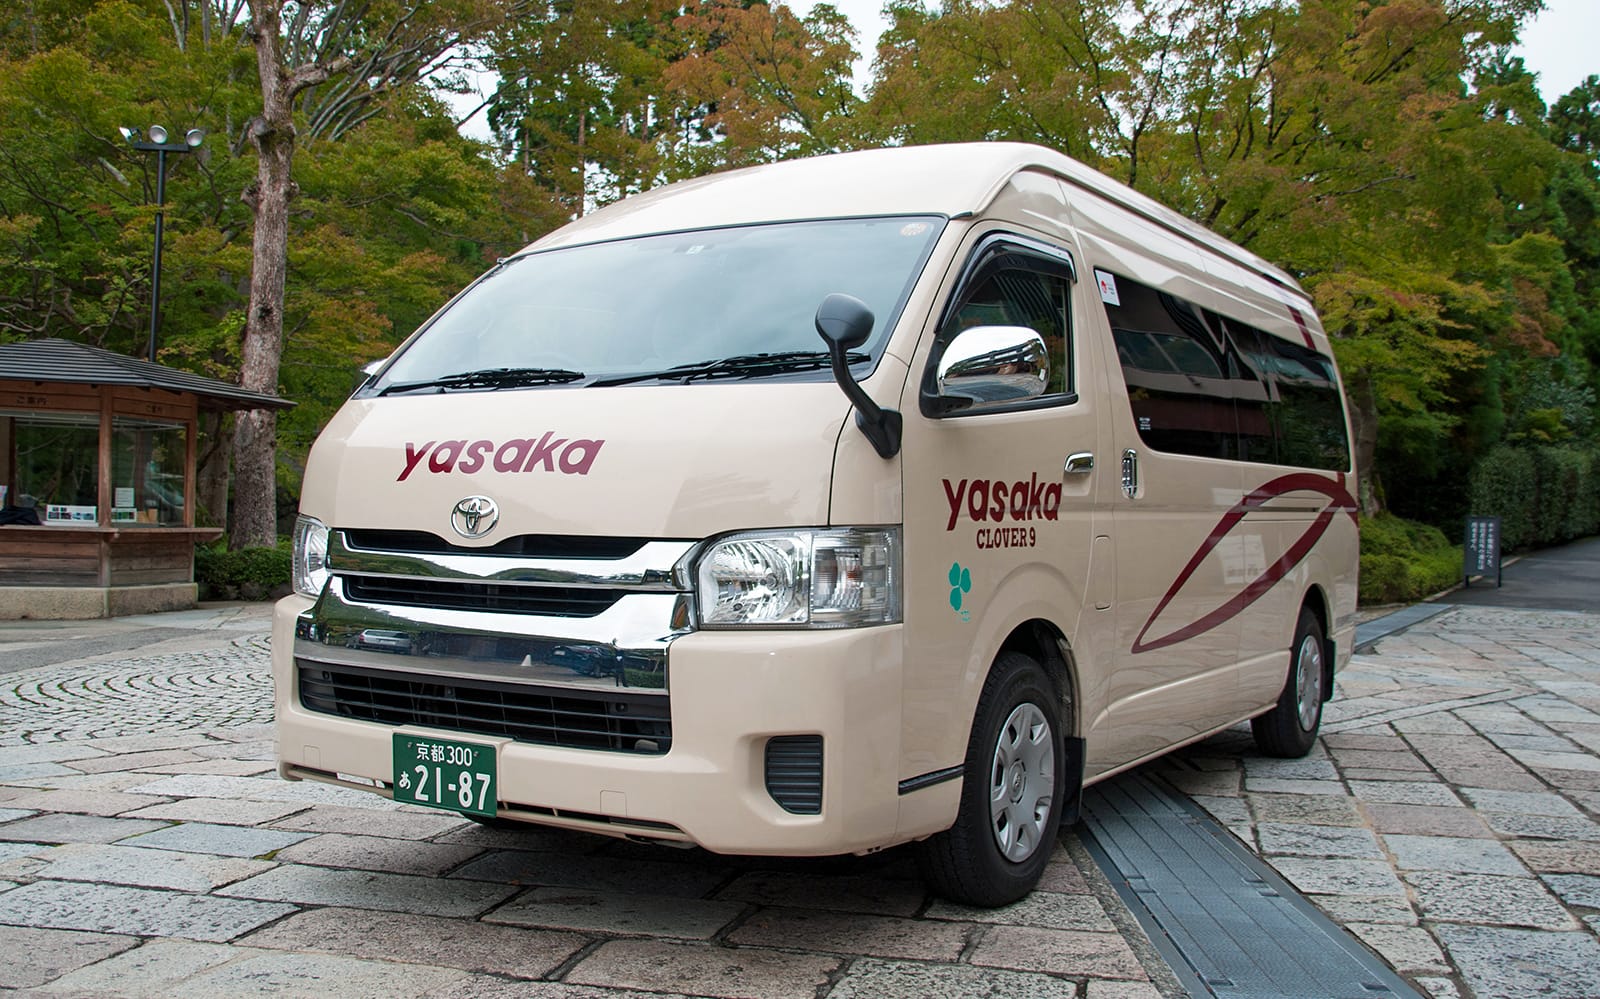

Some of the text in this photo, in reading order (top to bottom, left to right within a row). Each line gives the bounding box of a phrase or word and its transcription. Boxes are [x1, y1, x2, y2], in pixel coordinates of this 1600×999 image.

[396, 431, 605, 482] yasaka
[942, 472, 1062, 531] yasaka
[414, 765, 491, 811] 21-87
